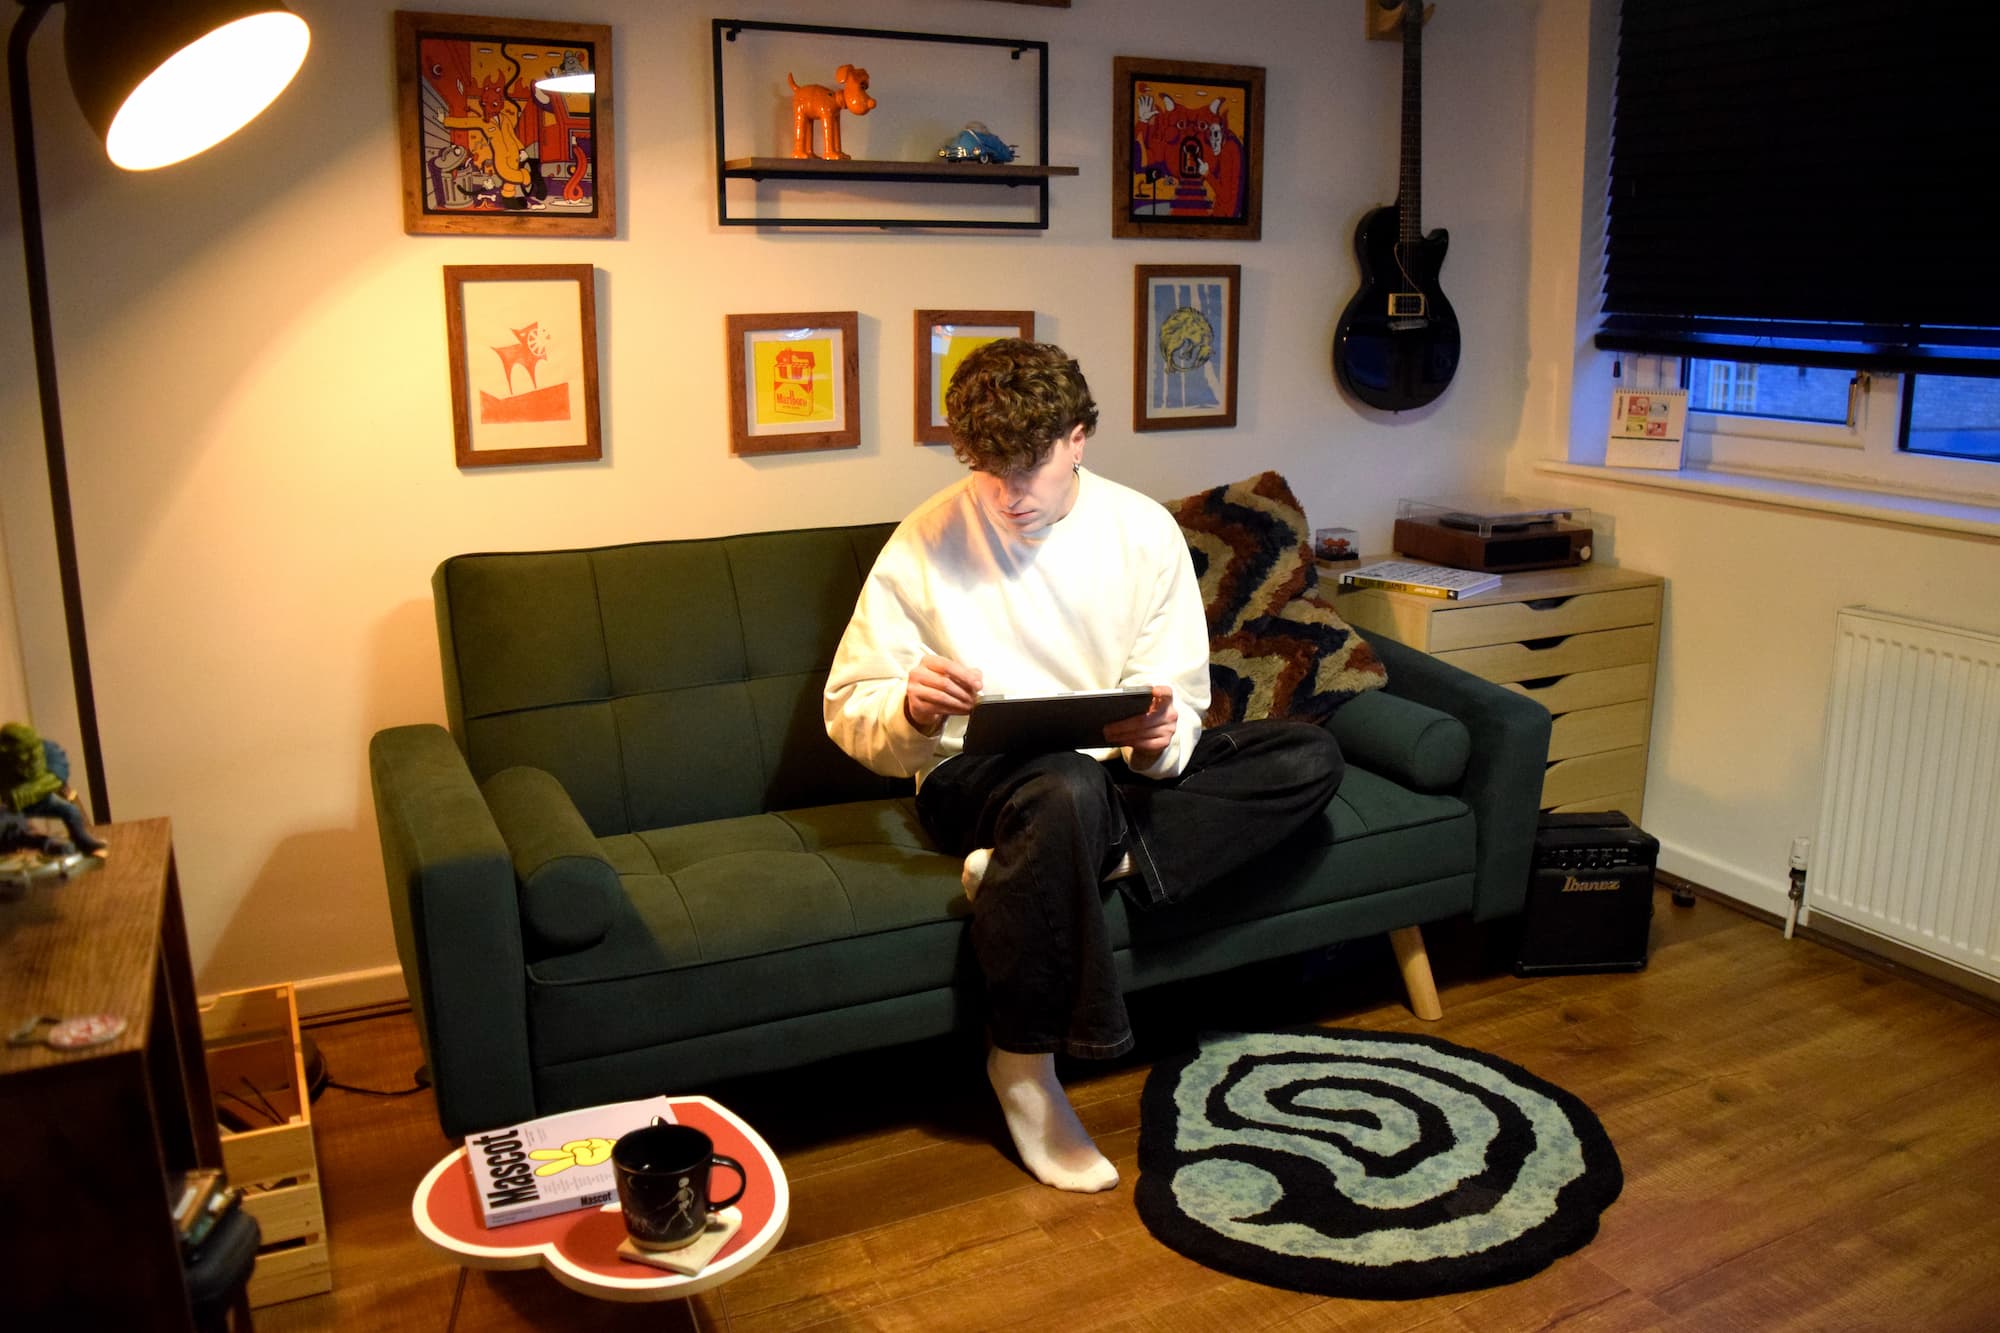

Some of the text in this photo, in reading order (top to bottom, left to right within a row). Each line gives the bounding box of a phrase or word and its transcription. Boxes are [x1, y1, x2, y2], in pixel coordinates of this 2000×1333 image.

[1562, 876, 1621, 892] Ibanez
[472, 1129, 540, 1209] Mascot
[580, 1191, 612, 1207] Mascot
